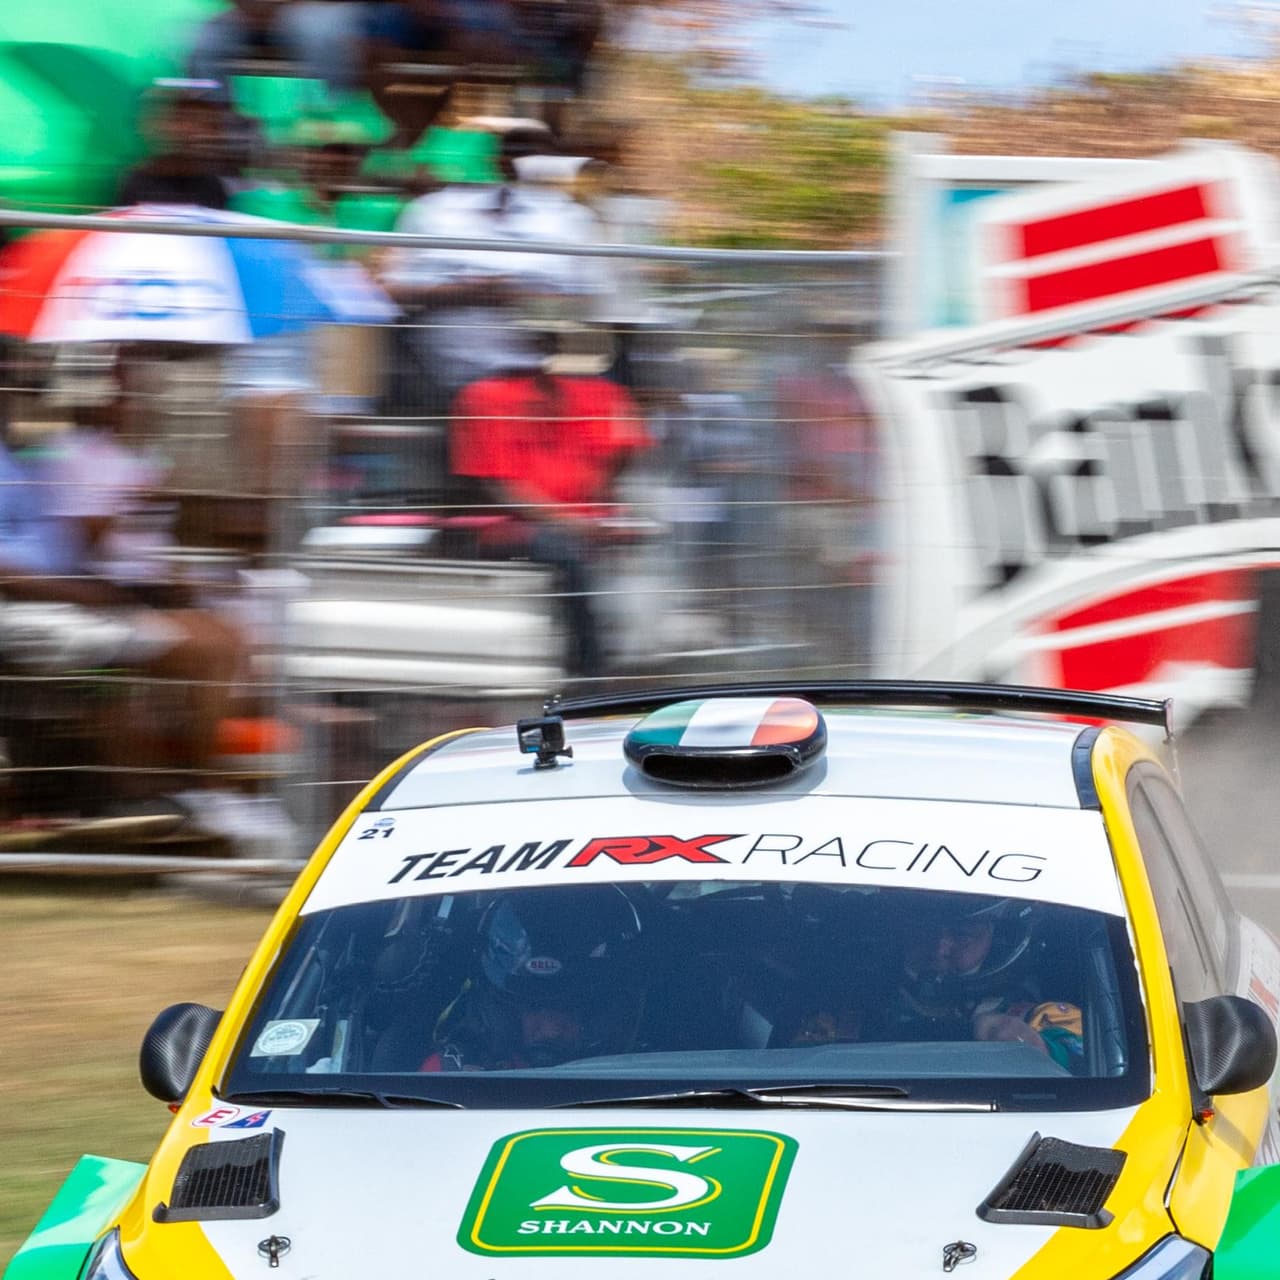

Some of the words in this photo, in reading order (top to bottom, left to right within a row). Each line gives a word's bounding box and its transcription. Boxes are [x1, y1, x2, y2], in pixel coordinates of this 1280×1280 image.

[357, 827, 395, 841] 21
[387, 838, 575, 884] TEAM
[563, 834, 749, 868] RX
[742, 833, 1048, 882] RACING
[517, 1220, 712, 1236] SHANNON
